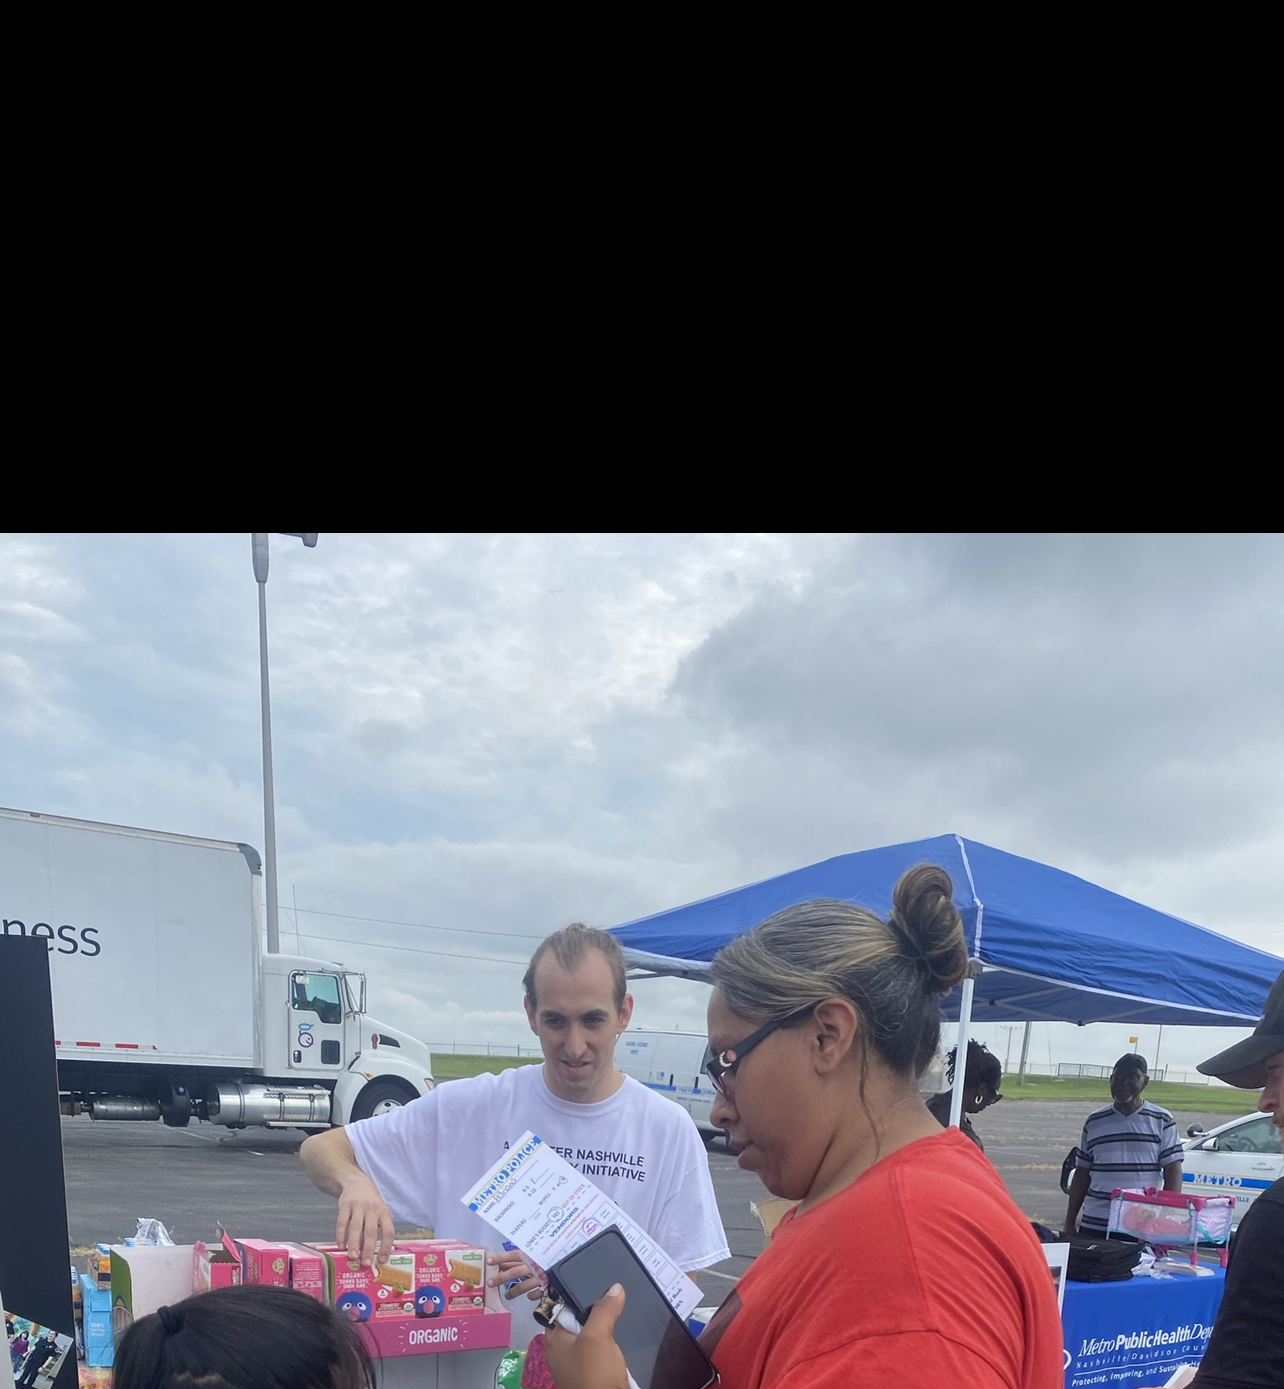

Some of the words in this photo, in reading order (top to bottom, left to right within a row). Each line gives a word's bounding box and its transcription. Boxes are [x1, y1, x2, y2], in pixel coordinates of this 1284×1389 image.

[3, 919, 101, 956] ness
[577, 1149, 645, 1167] NASHVILLE
[473, 1172, 508, 1206] METRO
[505, 1139, 539, 1173] POLICE
[582, 1163, 646, 1182] INITIATIVE
[1194, 1173, 1242, 1187] METRO
[561, 1199, 570, 1208] OUT
[573, 1184, 585, 1196] STOCK
[549, 1207, 579, 1237] VENDORS
[1072, 1374, 1108, 1387] Protecting,
[1110, 1369, 1144, 1381] Improving,
[1146, 1367, 1158, 1376] and
